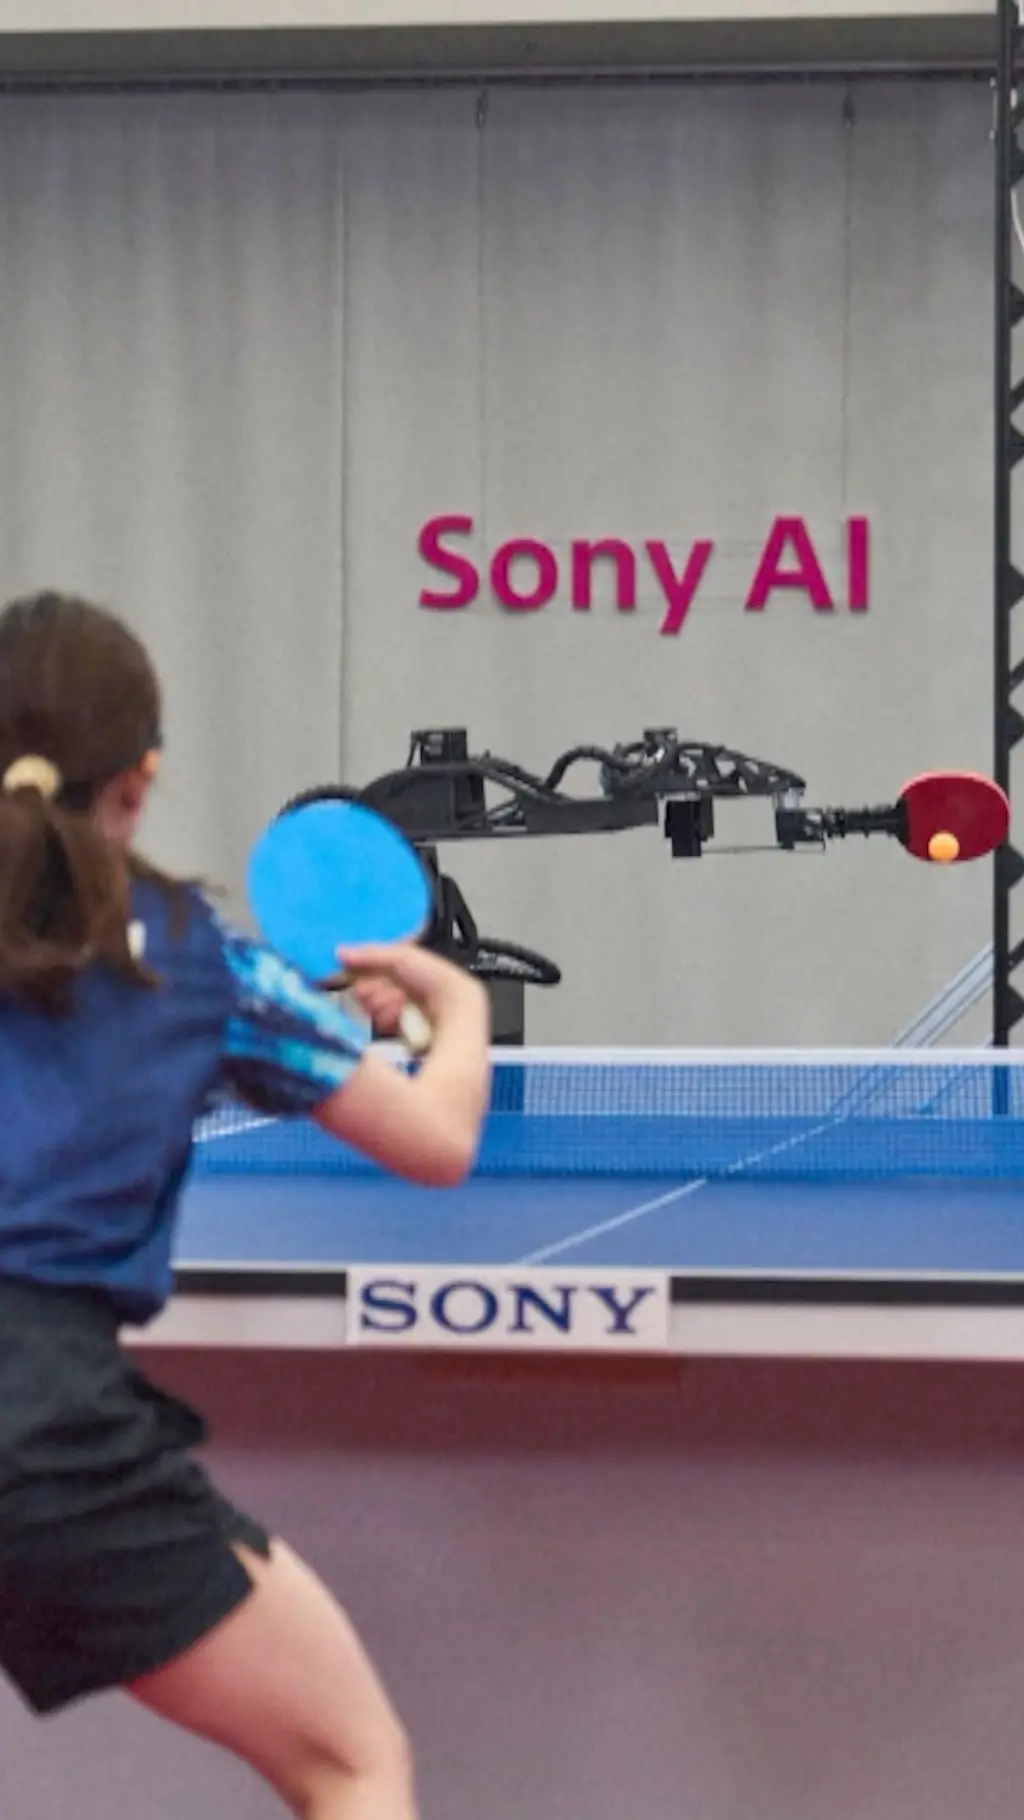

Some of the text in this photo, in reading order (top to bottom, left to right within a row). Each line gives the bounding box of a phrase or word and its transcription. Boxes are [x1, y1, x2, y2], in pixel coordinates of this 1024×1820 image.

[418, 513, 869, 635] Sony AI
[360, 1279, 656, 1335] SONY
